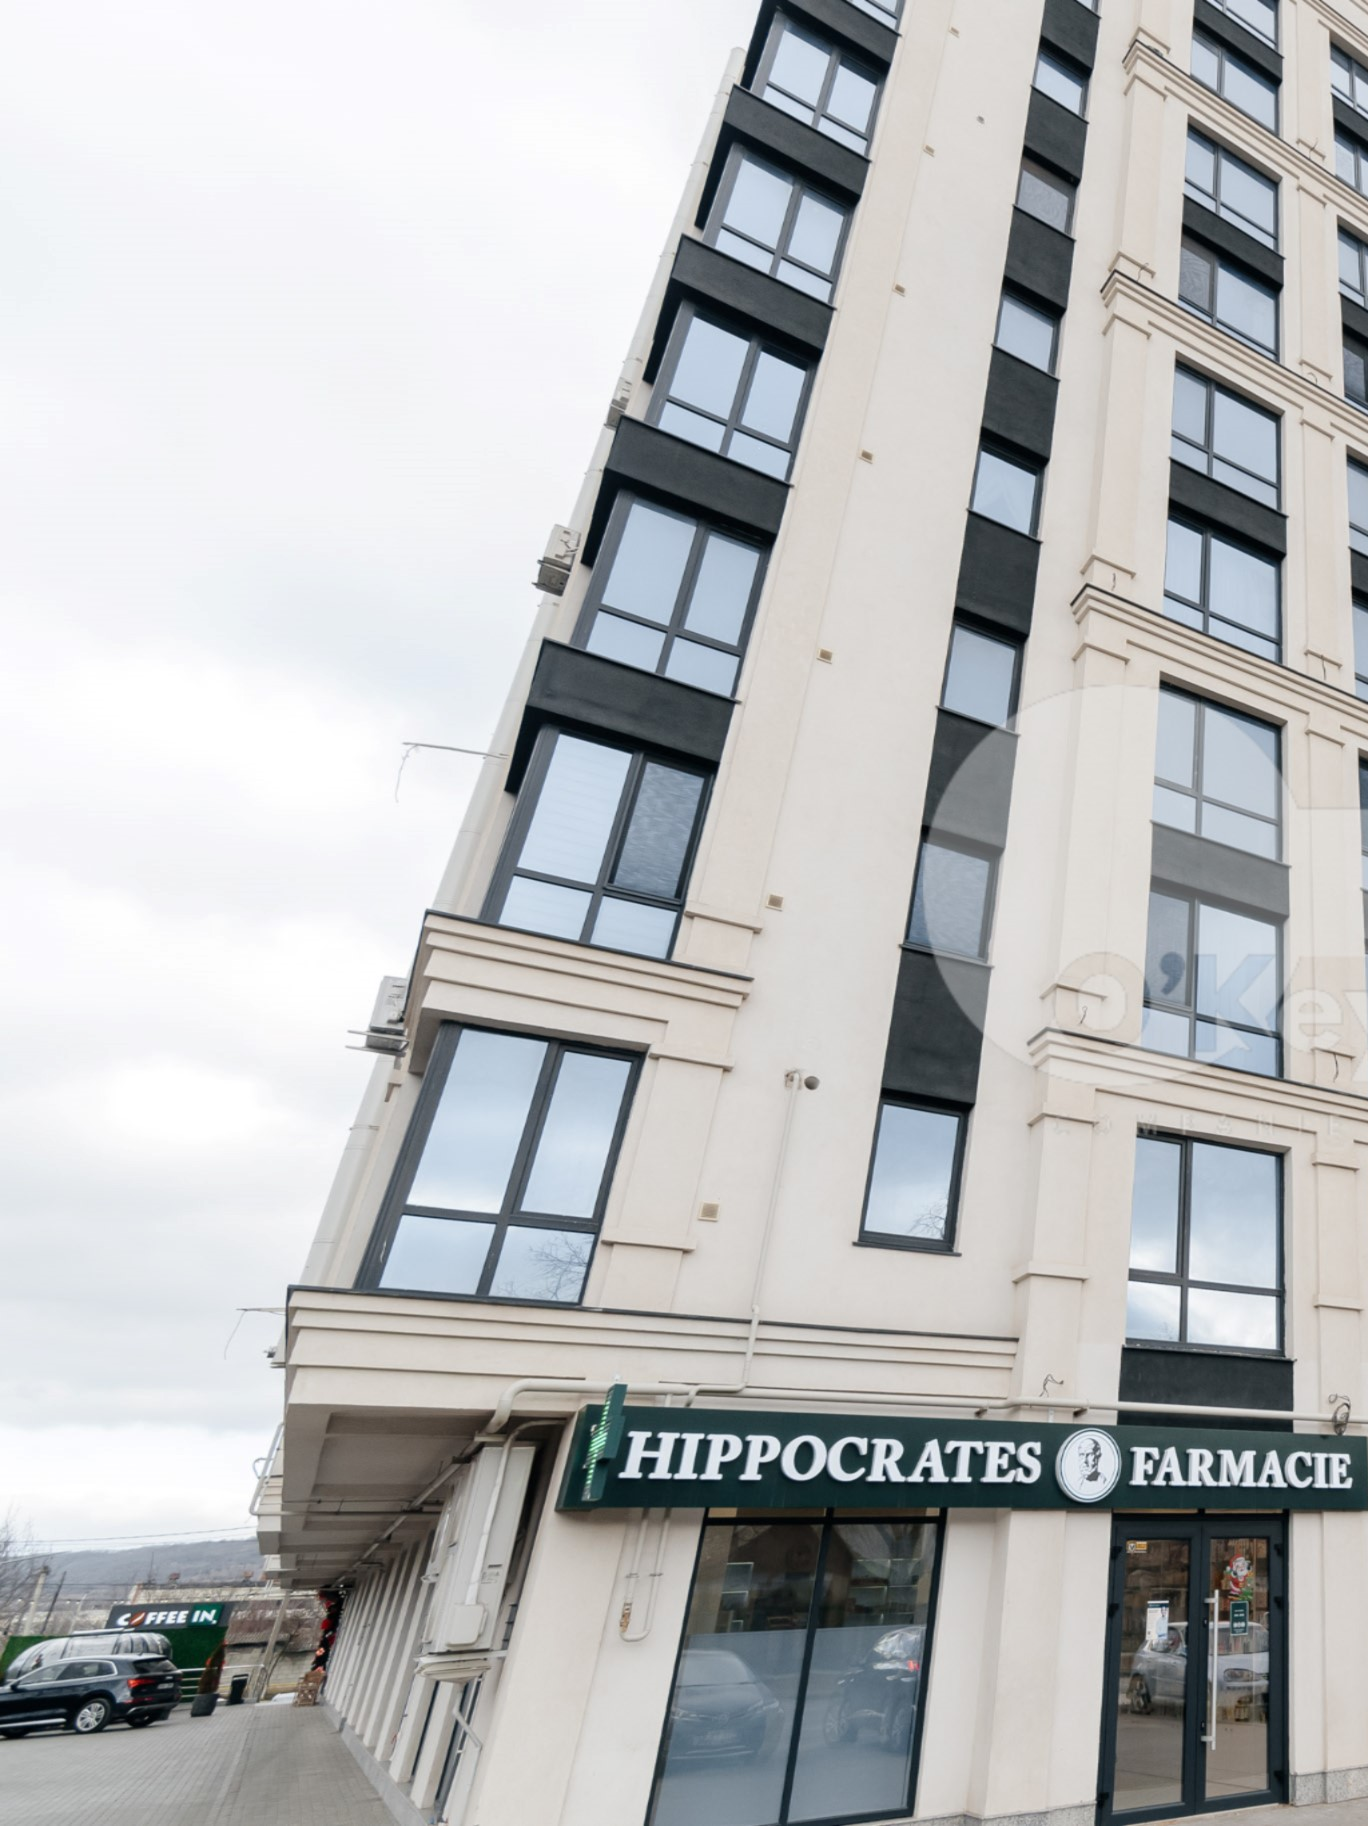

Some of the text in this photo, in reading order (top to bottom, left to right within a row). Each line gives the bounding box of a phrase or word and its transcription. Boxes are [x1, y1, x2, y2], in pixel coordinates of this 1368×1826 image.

[618, 1430, 1353, 1490] HIPPOCRATES FARMACIE
[116, 1610, 190, 1627] COFFEE
